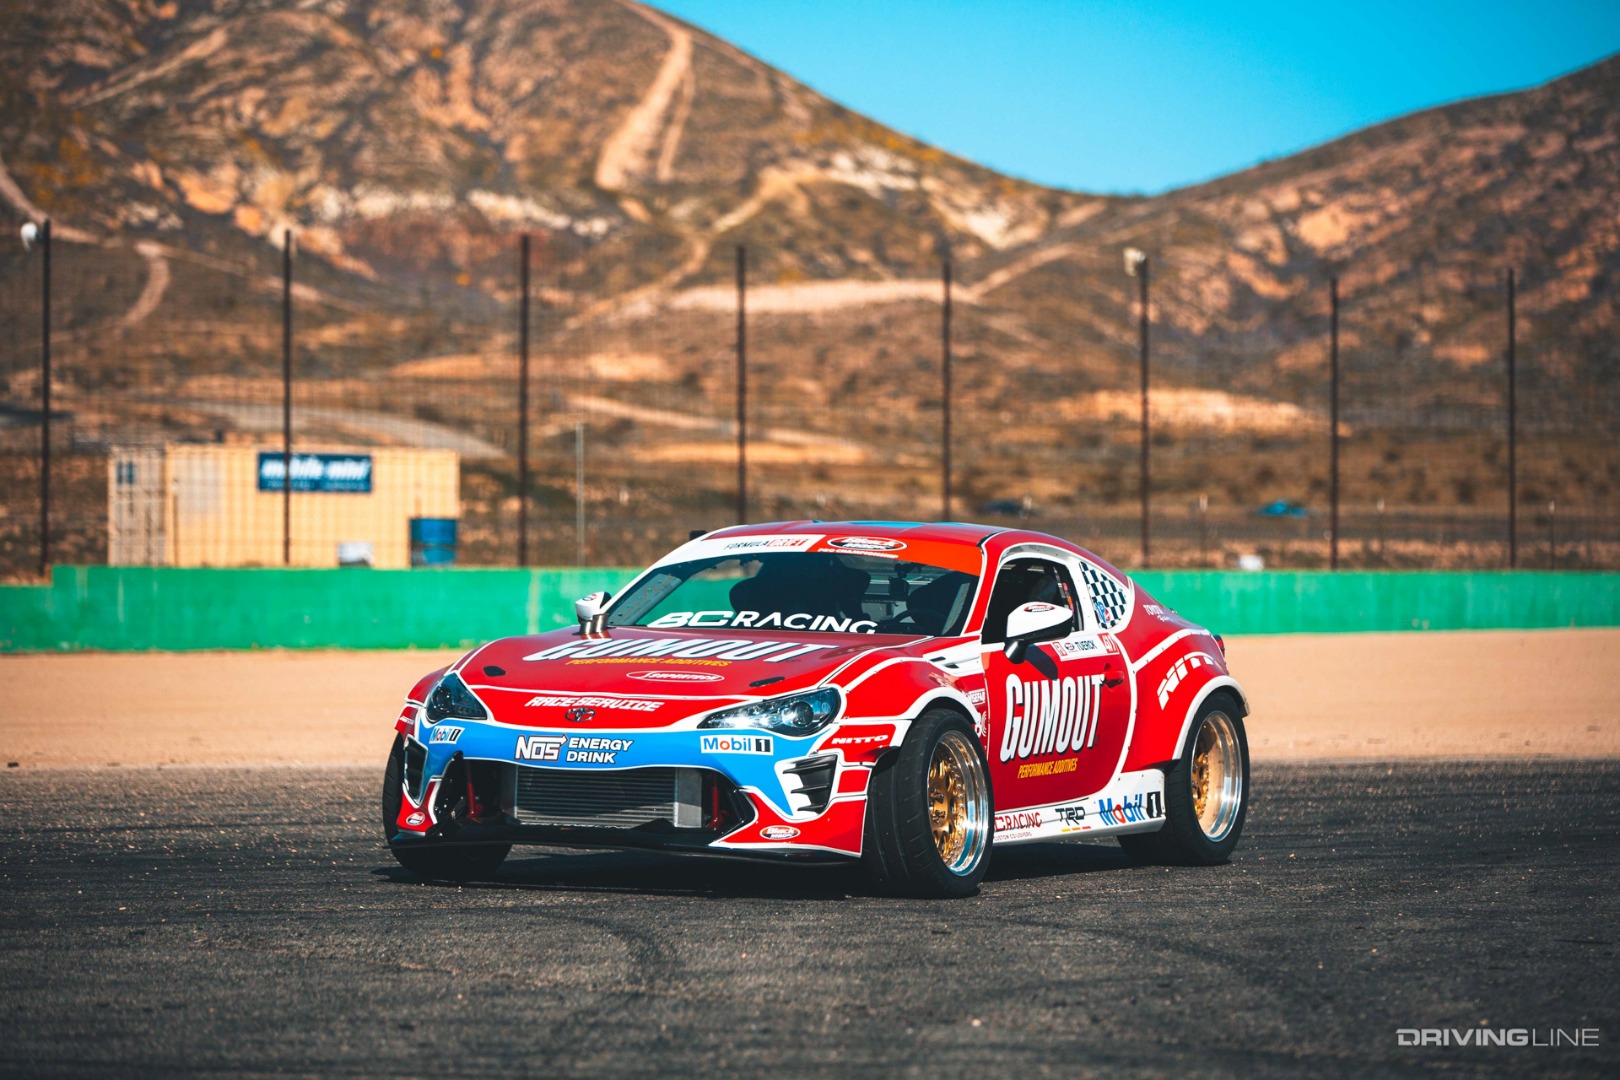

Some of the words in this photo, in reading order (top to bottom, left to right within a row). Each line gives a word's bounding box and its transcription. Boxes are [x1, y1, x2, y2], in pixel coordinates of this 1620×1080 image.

[522, 638, 840, 663] GUMOUT
[565, 657, 663, 667] PERFORMANCE
[663, 658, 732, 668] ADDITIVES
[1000, 673, 1105, 764] GUMOUT
[430, 728, 452, 742] Mobil
[703, 737, 751, 752] Mobil
[757, 739, 768, 752] 1
[831, 734, 889, 745] NITTO
[515, 734, 565, 761] NOS
[568, 737, 633, 752] ENERGY
[566, 750, 617, 764] DRINK
[1017, 761, 1055, 779] PERFORMANCE
[1053, 757, 1079, 775] ADDITIVES
[1055, 806, 1086, 827] TRD
[1099, 793, 1146, 826] Mobil
[1149, 793, 1159, 818] 1
